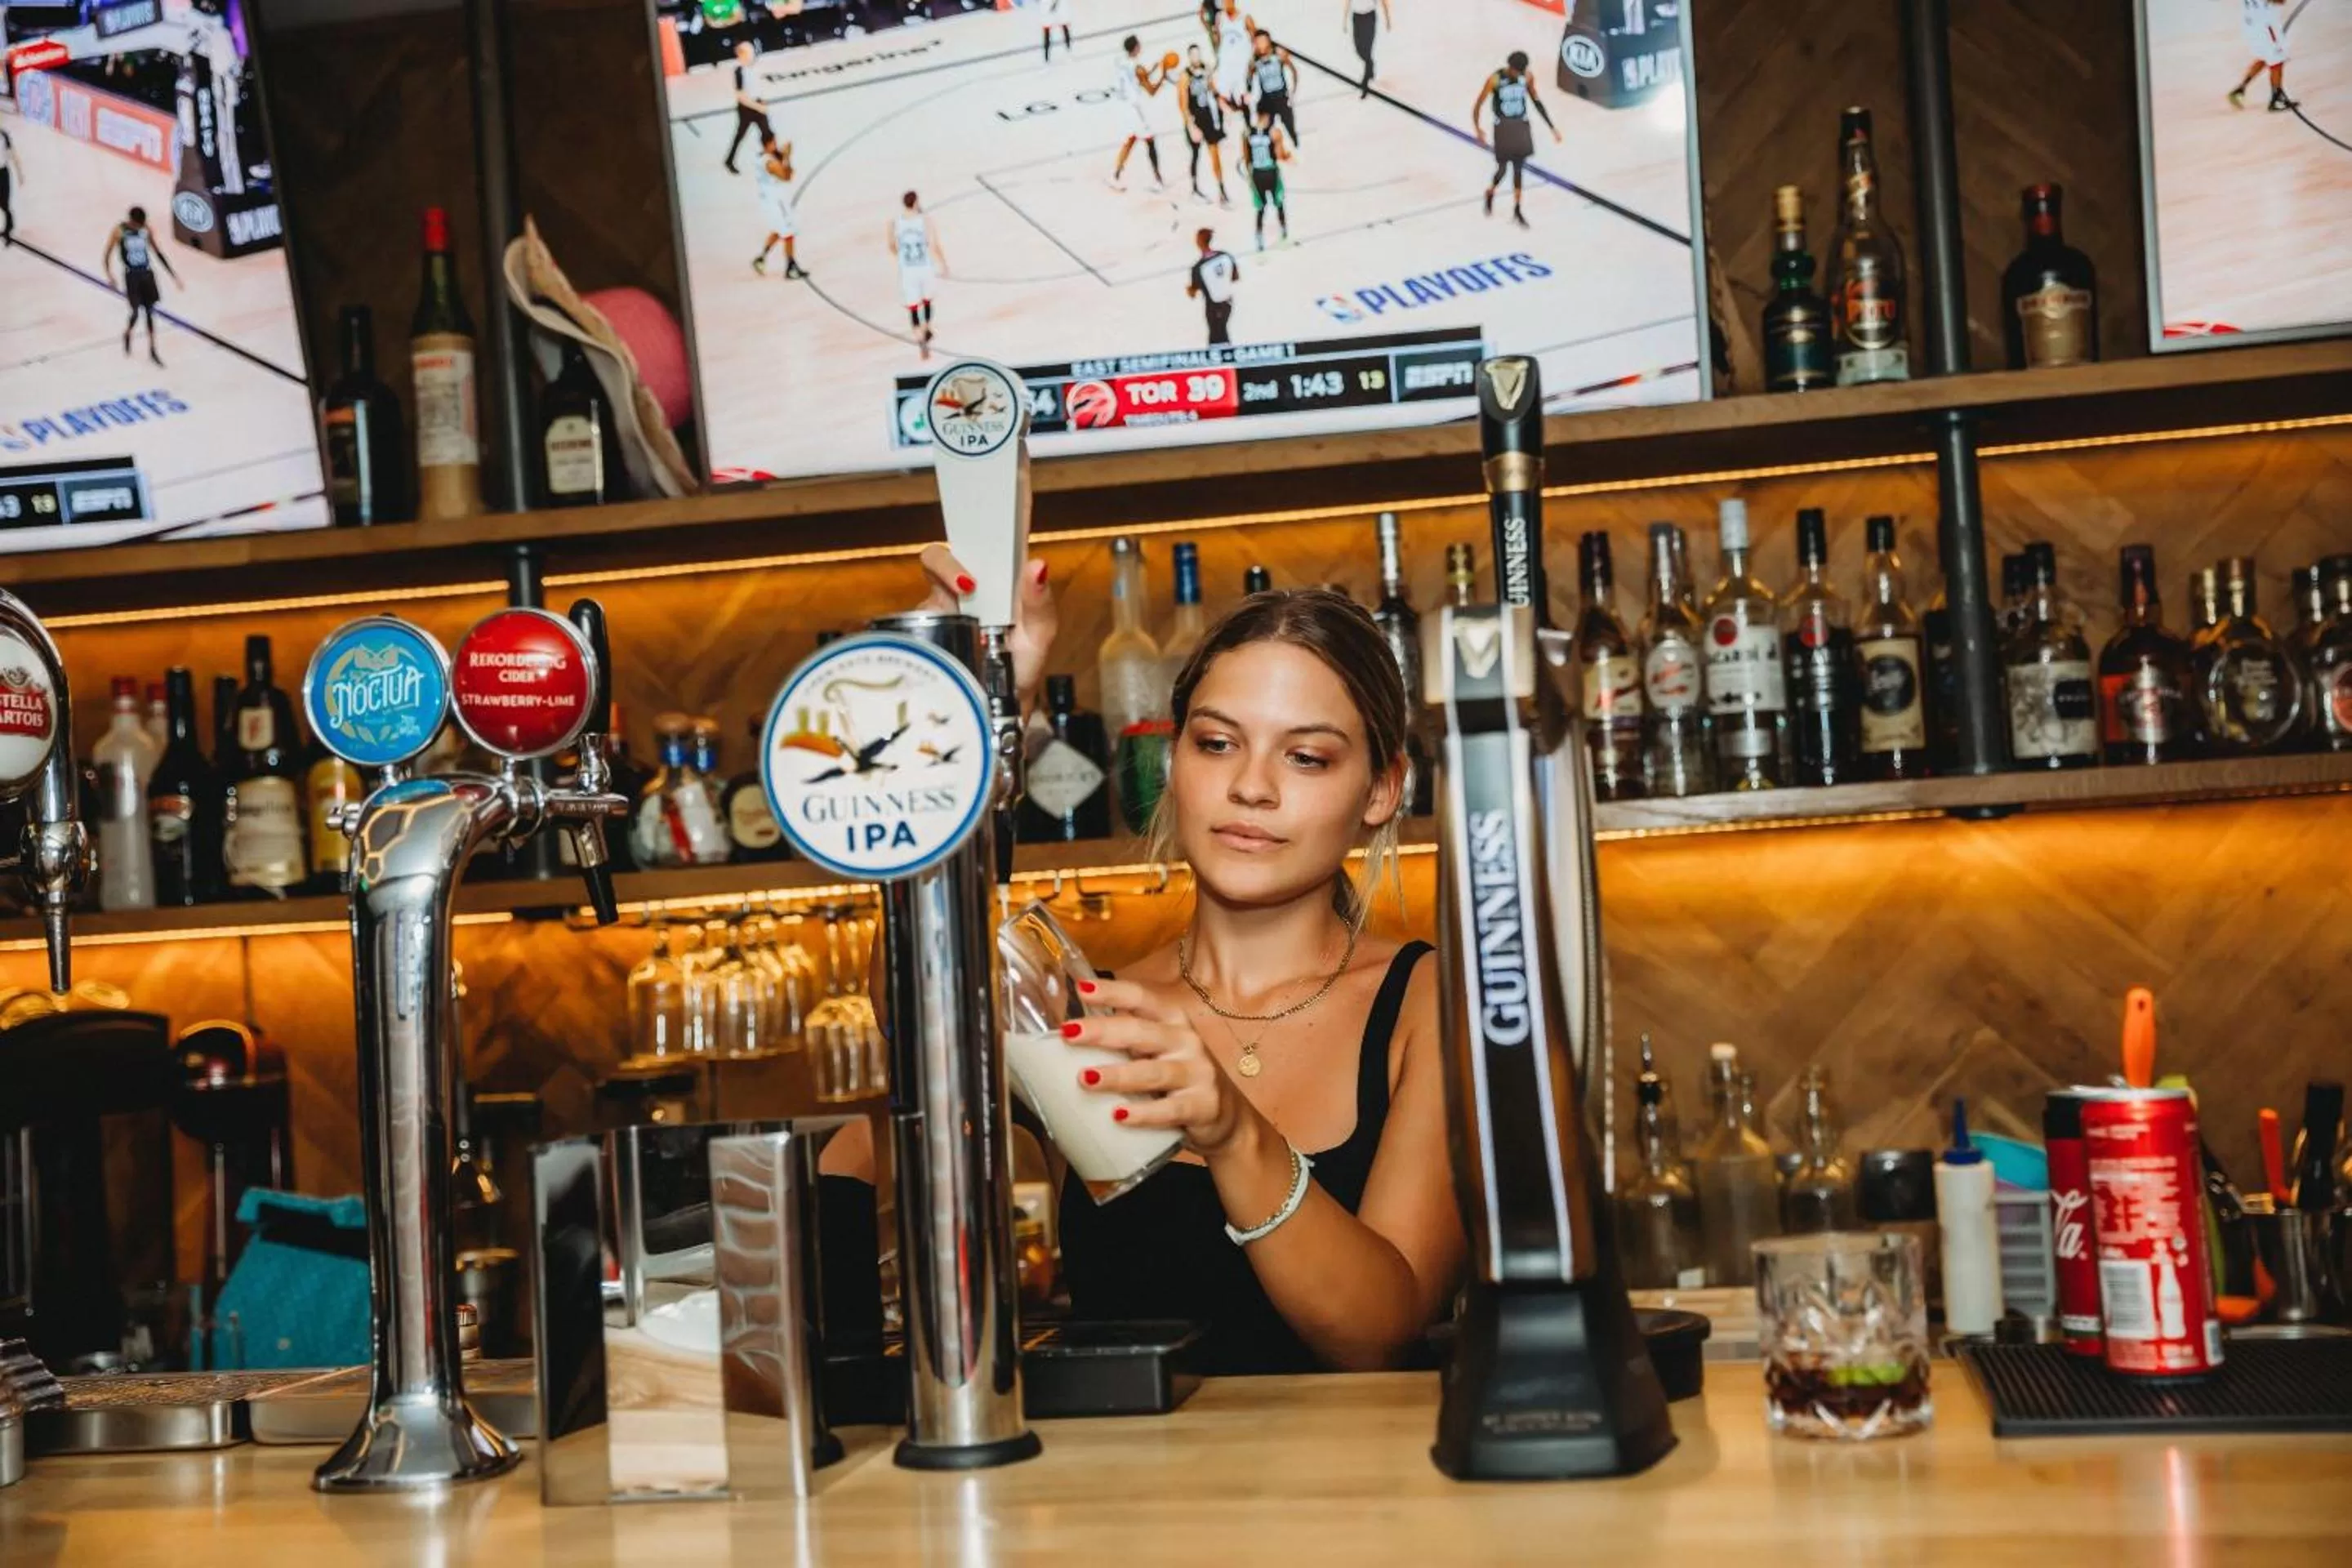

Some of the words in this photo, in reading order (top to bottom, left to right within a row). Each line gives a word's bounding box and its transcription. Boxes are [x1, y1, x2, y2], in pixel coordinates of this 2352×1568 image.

[1354, 252, 1552, 314] PLAYOFFS
[1125, 380, 1178, 406] TOR
[1242, 380, 1279, 401] 2nd
[1290, 370, 1345, 399] 1:43
[1403, 362, 1473, 389] ESPN
[960, 434, 989, 448] IPA
[1503, 516, 1530, 608] UINNESS
[469, 652, 568, 670] REKORDG
[498, 669, 536, 684] CIDER
[329, 662, 426, 729] NOCTUA
[461, 693, 576, 707] STRAWBERRY-LIME
[802, 786, 957, 825] GUINNESS
[847, 820, 917, 853] IPA
[1470, 808, 1530, 1046] GUINNESS
